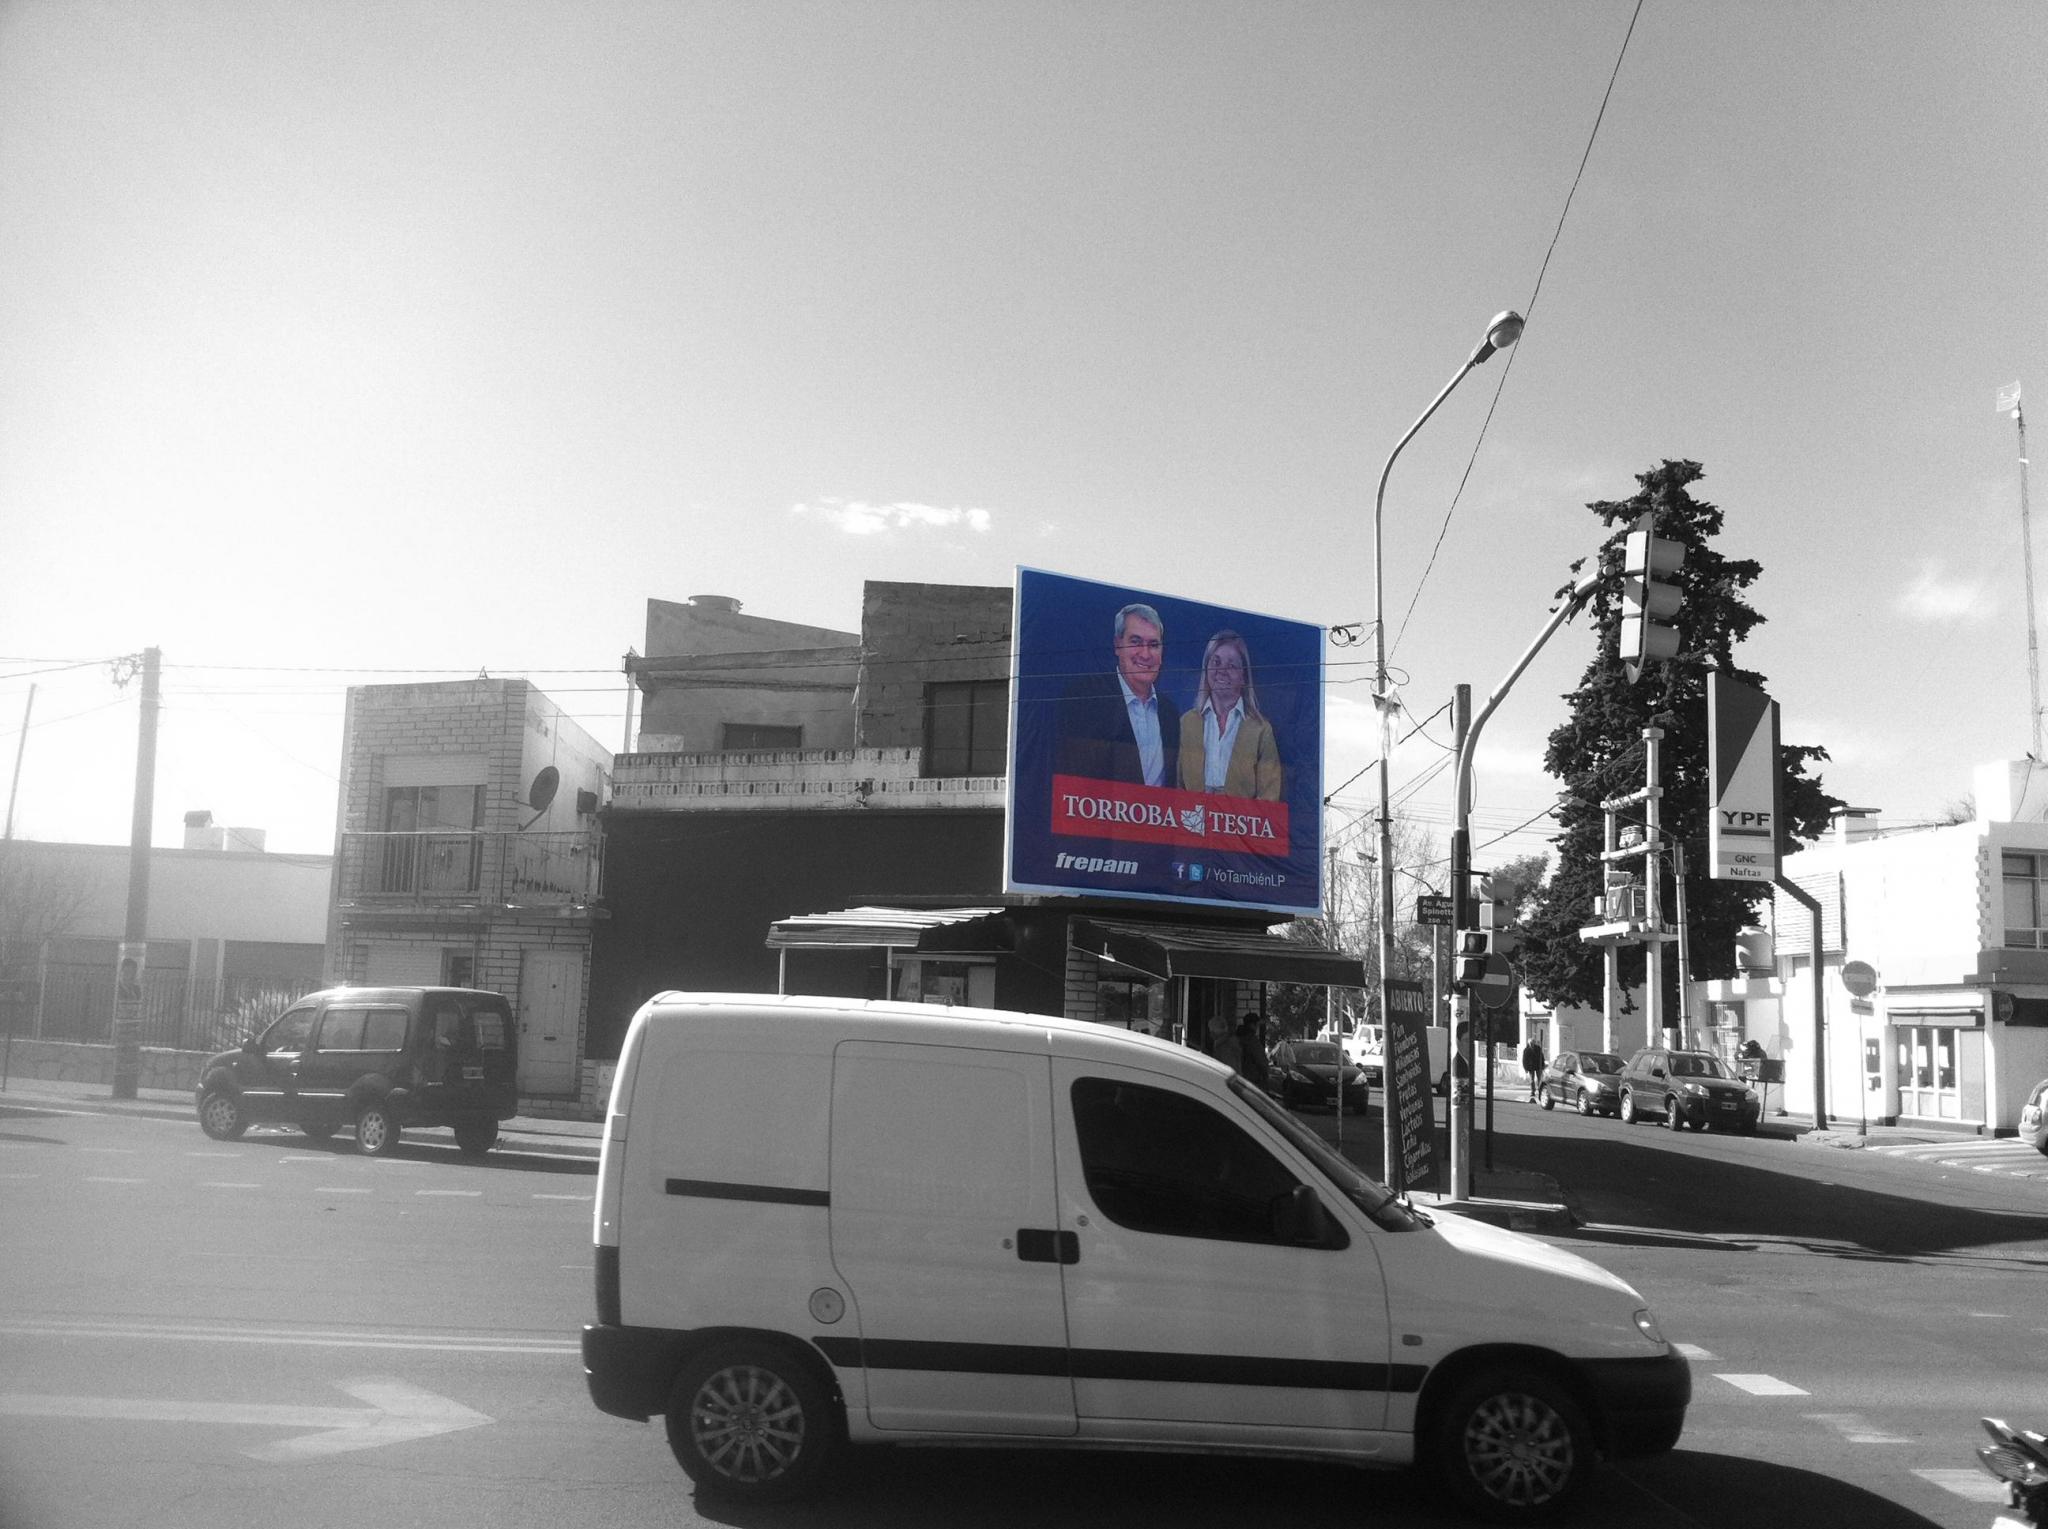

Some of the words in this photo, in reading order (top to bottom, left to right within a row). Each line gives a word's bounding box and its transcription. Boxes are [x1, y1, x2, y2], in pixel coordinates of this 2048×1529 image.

[1063, 794, 1178, 828] TORROBA
[1208, 811, 1276, 839] TESTA
[1721, 810, 1771, 826] YPF
[1055, 852, 1139, 875] frepam
[1734, 854, 1757, 864] GNC
[1213, 867, 1287, 887] YoTambiénLP
[1730, 867, 1762, 877] Naftas
[1390, 988, 1424, 1013] ABIERTO
